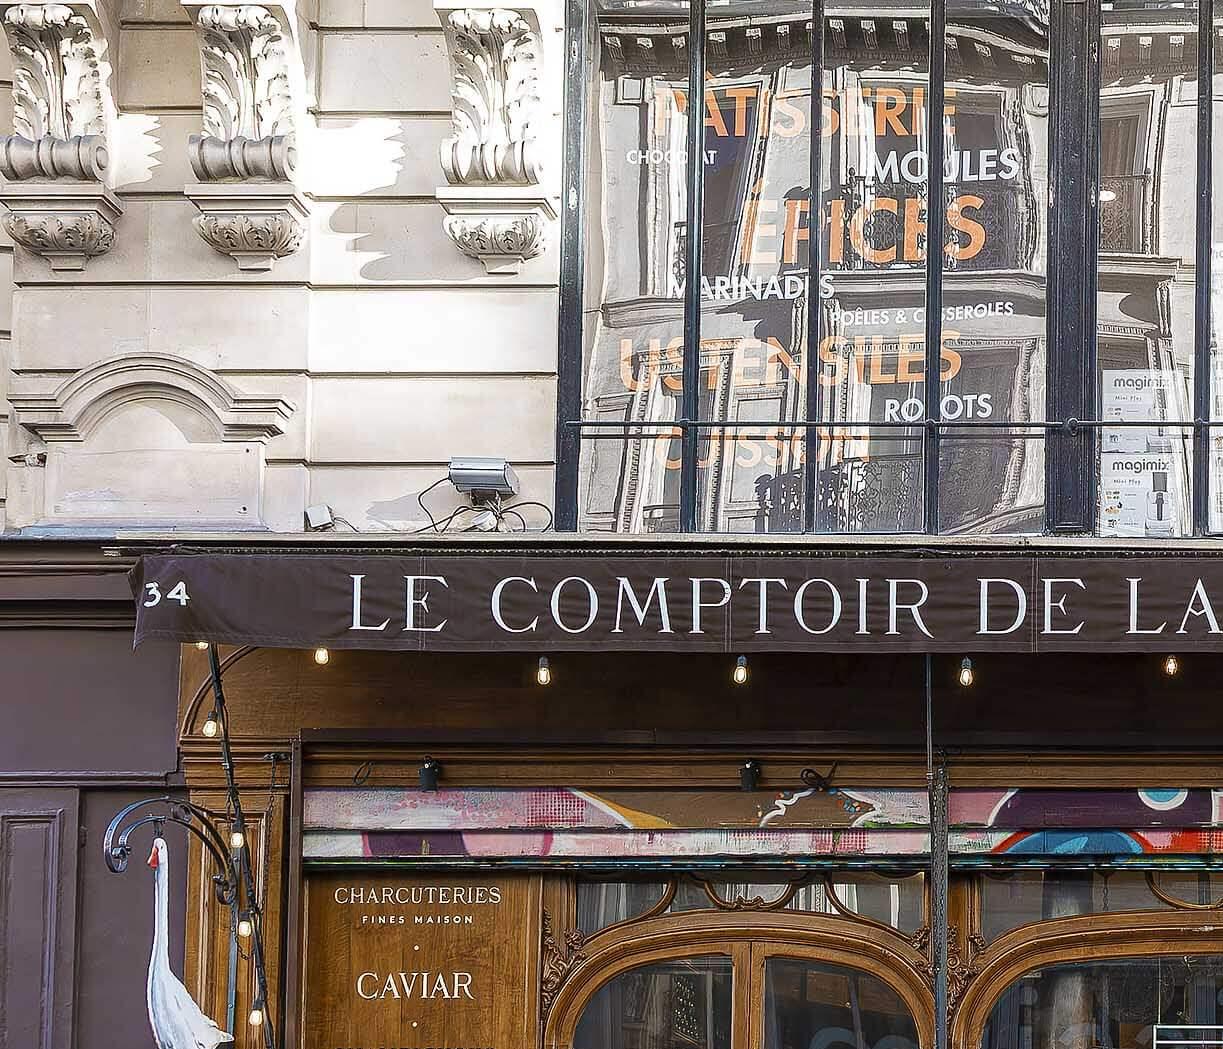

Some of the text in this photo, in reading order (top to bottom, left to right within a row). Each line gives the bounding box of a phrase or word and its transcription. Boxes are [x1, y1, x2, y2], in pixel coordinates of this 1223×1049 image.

[866, 148, 1019, 184] MOULES
[895, 310, 907, 324] &
[884, 393, 993, 423] ROOTS
[1112, 458, 1170, 474] magimix
[144, 580, 190, 607] 34
[348, 574, 448, 633] LE
[490, 575, 937, 636] COMPTOIR
[975, 576, 1084, 636] DE
[1125, 576, 1223, 634] LA
[334, 887, 501, 905] CHARCUTERIES
[362, 915, 474, 924] FINES MAISON
[356, 972, 475, 1000] CAVIAR
